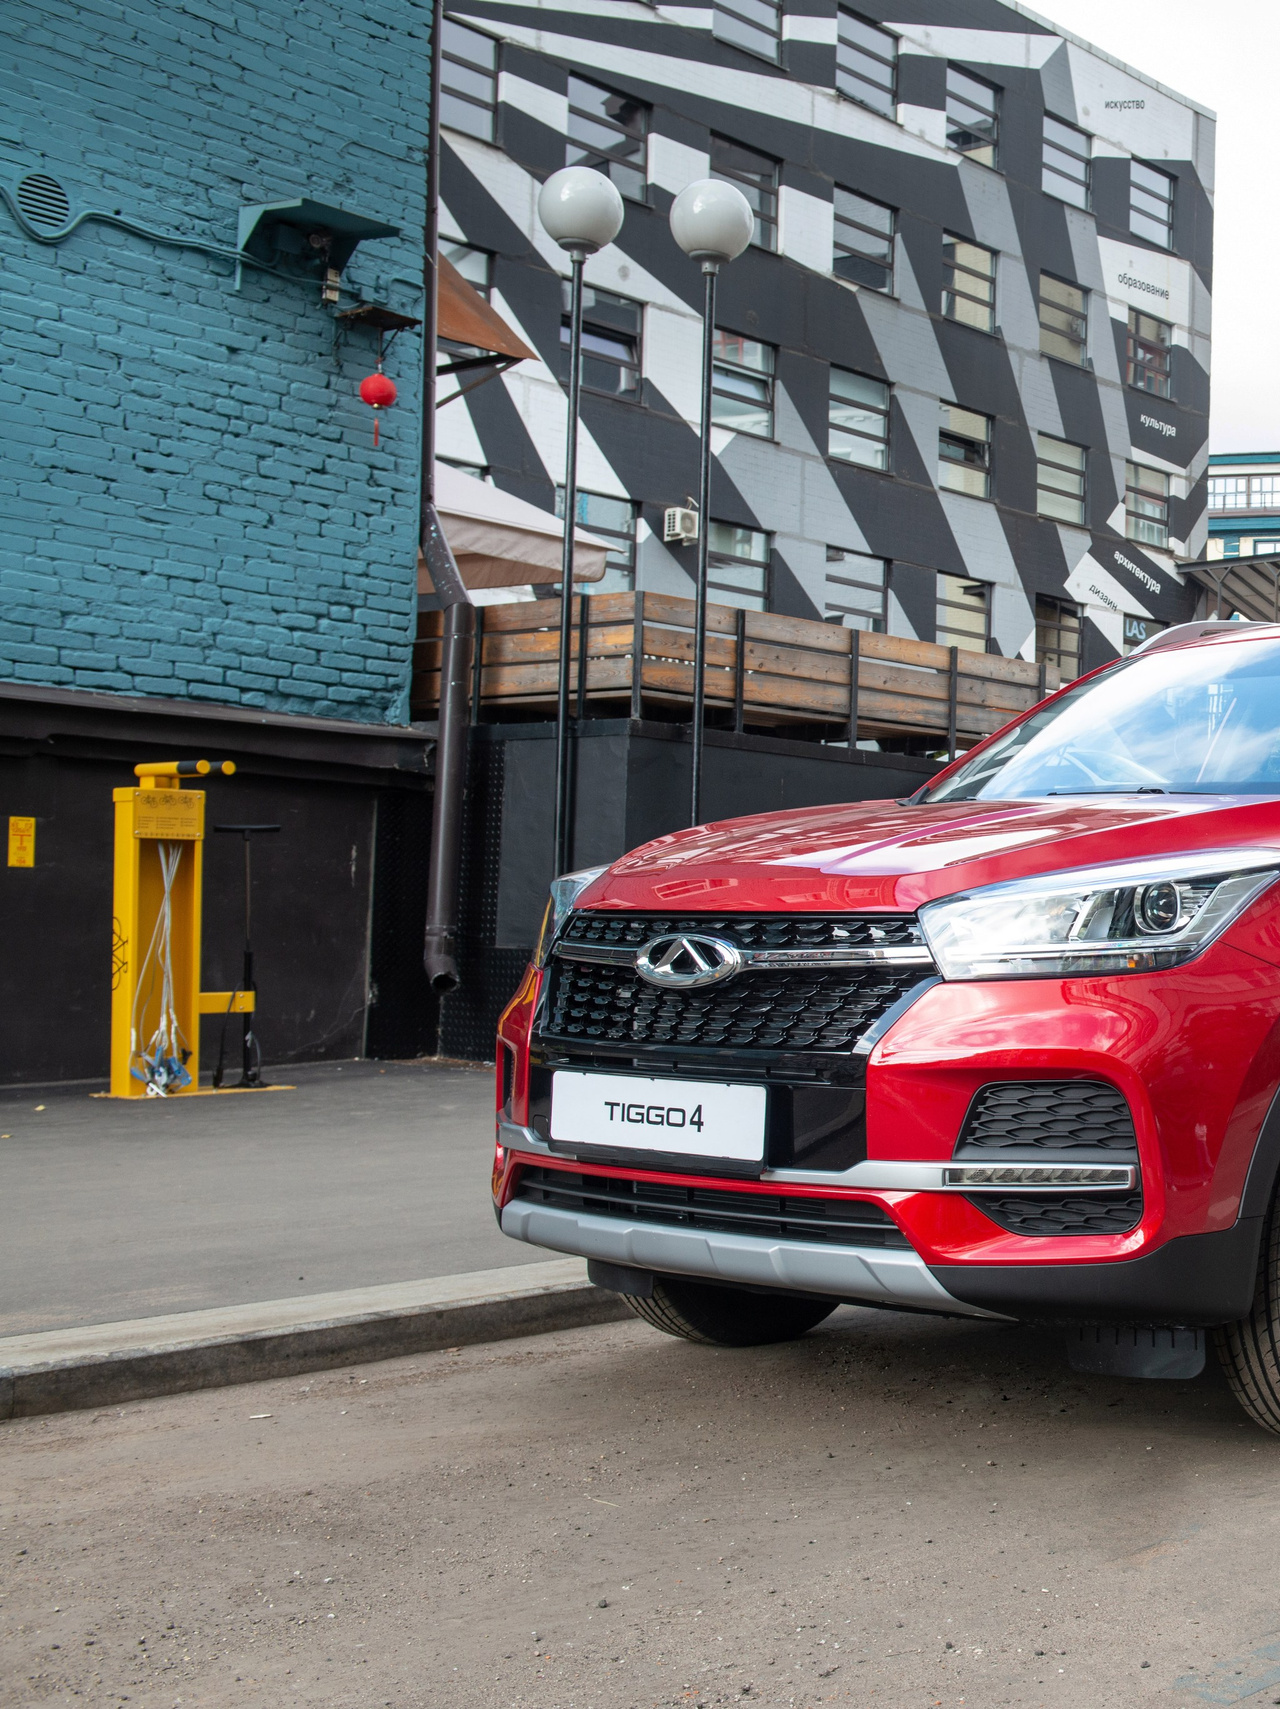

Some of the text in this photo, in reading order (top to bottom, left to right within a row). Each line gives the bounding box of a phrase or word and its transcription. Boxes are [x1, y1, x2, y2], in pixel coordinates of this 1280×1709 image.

[1104, 99, 1145, 112] искусство
[1117, 272, 1170, 300] образование
[1139, 413, 1177, 437] культура
[1113, 550, 1162, 595] архитектура
[1125, 618, 1147, 640] LAS
